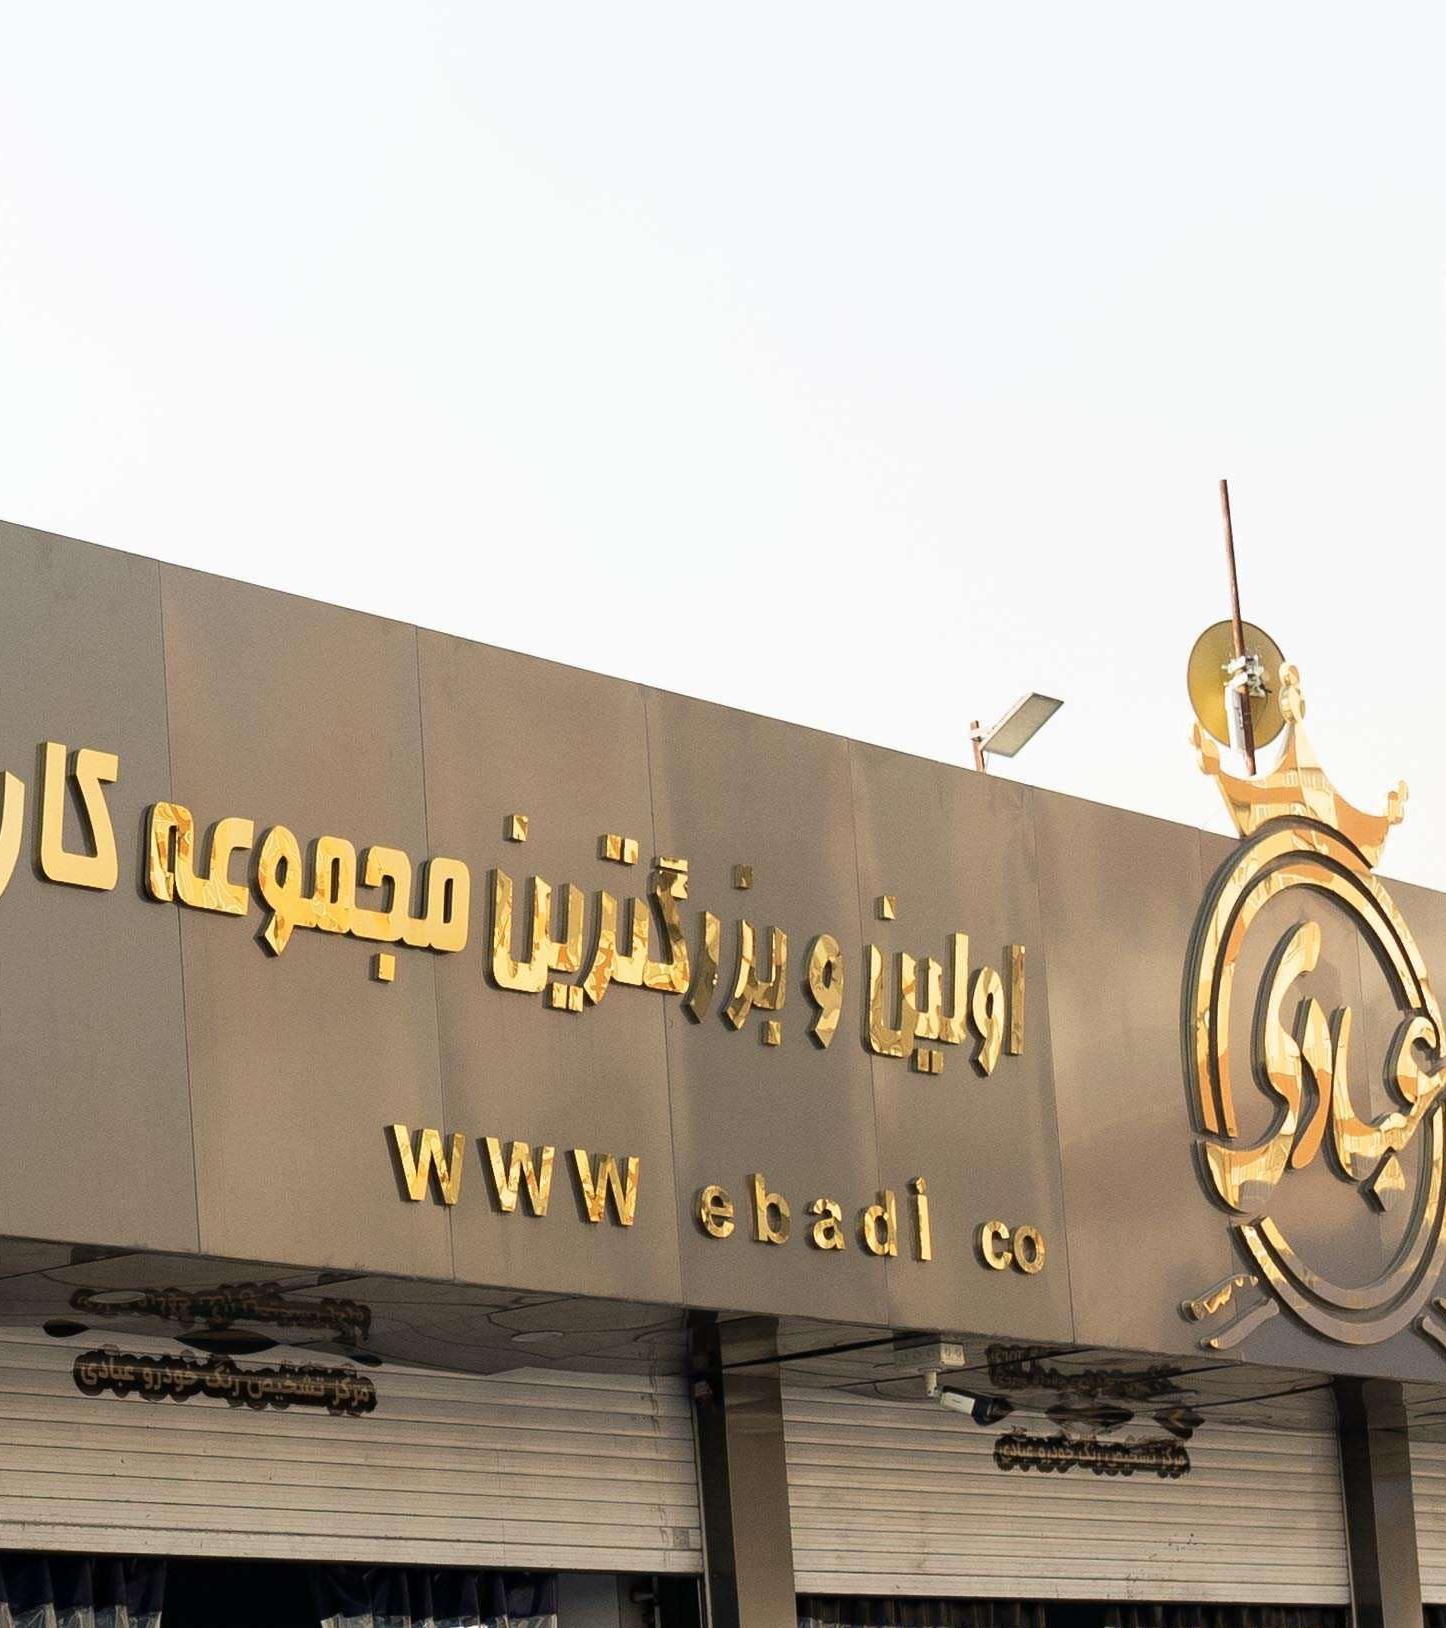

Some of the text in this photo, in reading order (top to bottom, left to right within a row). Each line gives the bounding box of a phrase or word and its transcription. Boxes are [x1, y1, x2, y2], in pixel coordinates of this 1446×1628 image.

[146, 798, 470, 982] مجموعه
[490, 815, 789, 1046] بزرگترین
[806, 934, 844, 1048] و
[866, 895, 1025, 1076] اولین
[698, 1177, 931, 1261] ebadi
[978, 1220, 1046, 1274] co
